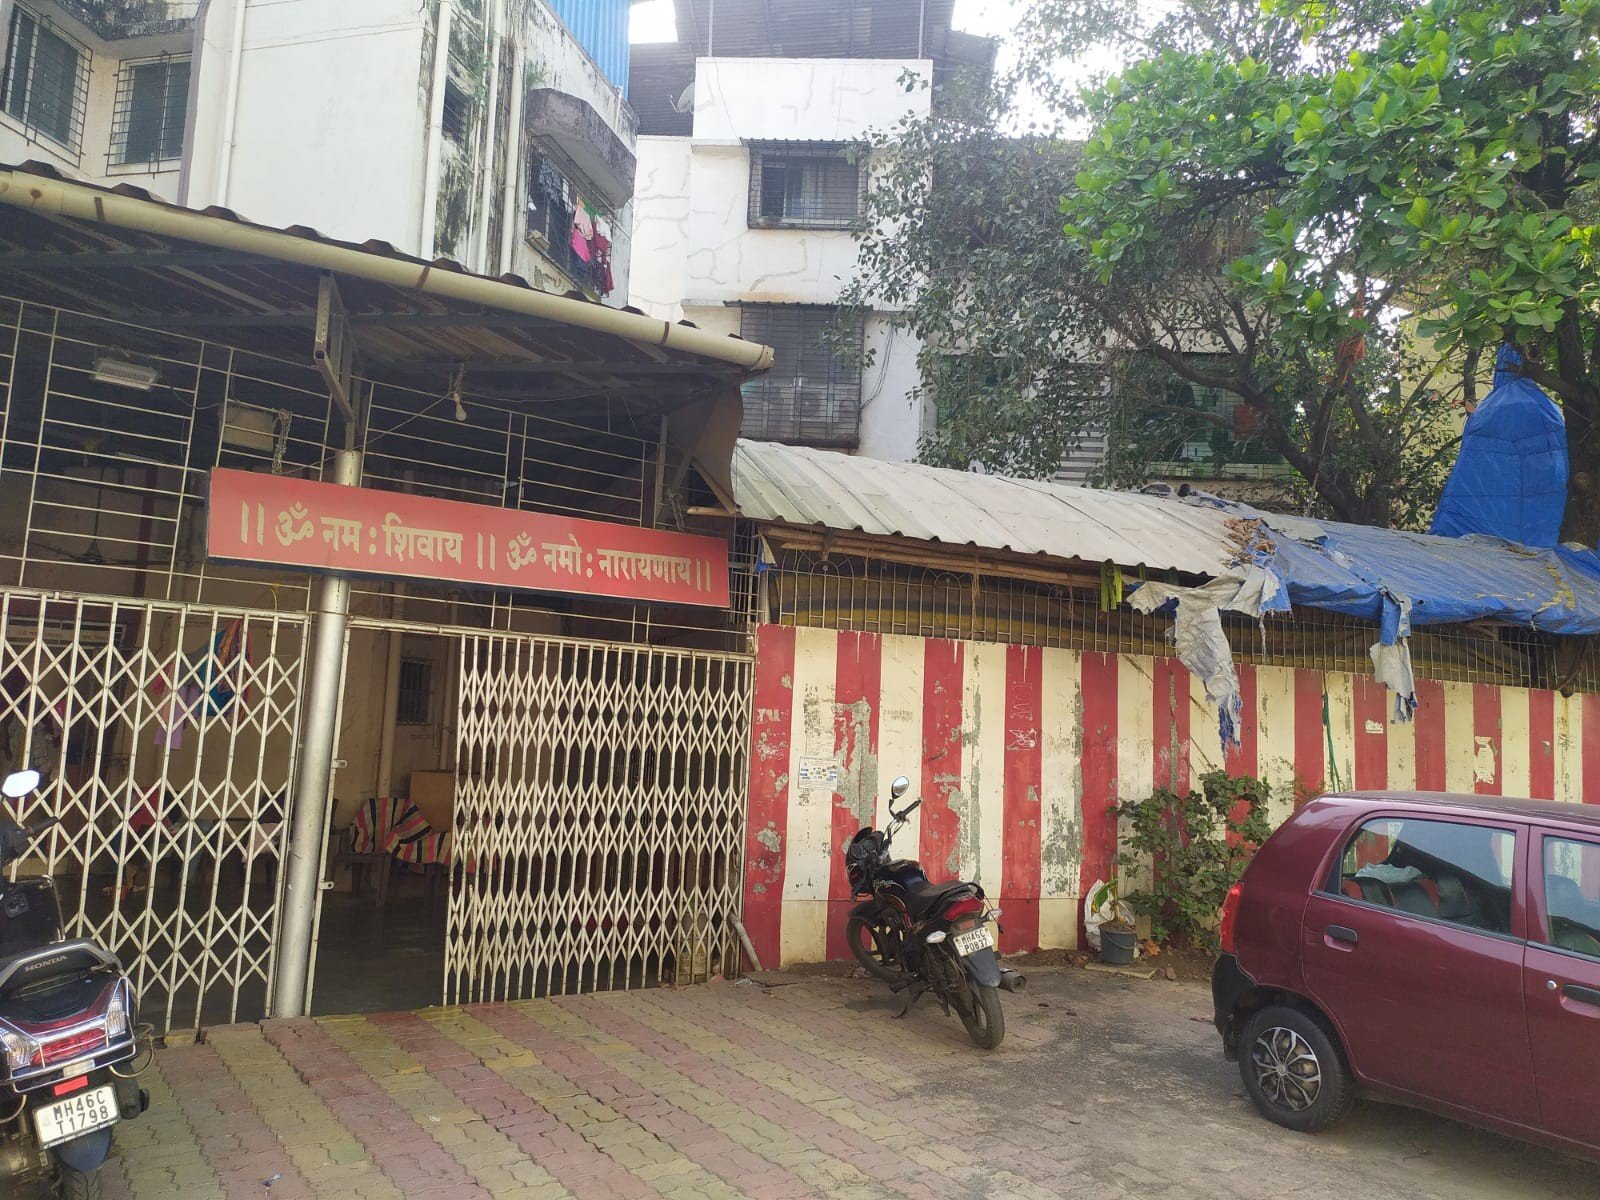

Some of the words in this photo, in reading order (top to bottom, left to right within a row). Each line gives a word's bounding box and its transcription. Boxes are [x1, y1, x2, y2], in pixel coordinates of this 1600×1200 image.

[274, 500, 315, 547] ॐ
[506, 530, 537, 571] ॐ
[24, 955, 69, 972] HONDA
[52, 1090, 106, 1121] MH46C
[55, 1105, 109, 1135] T1798
